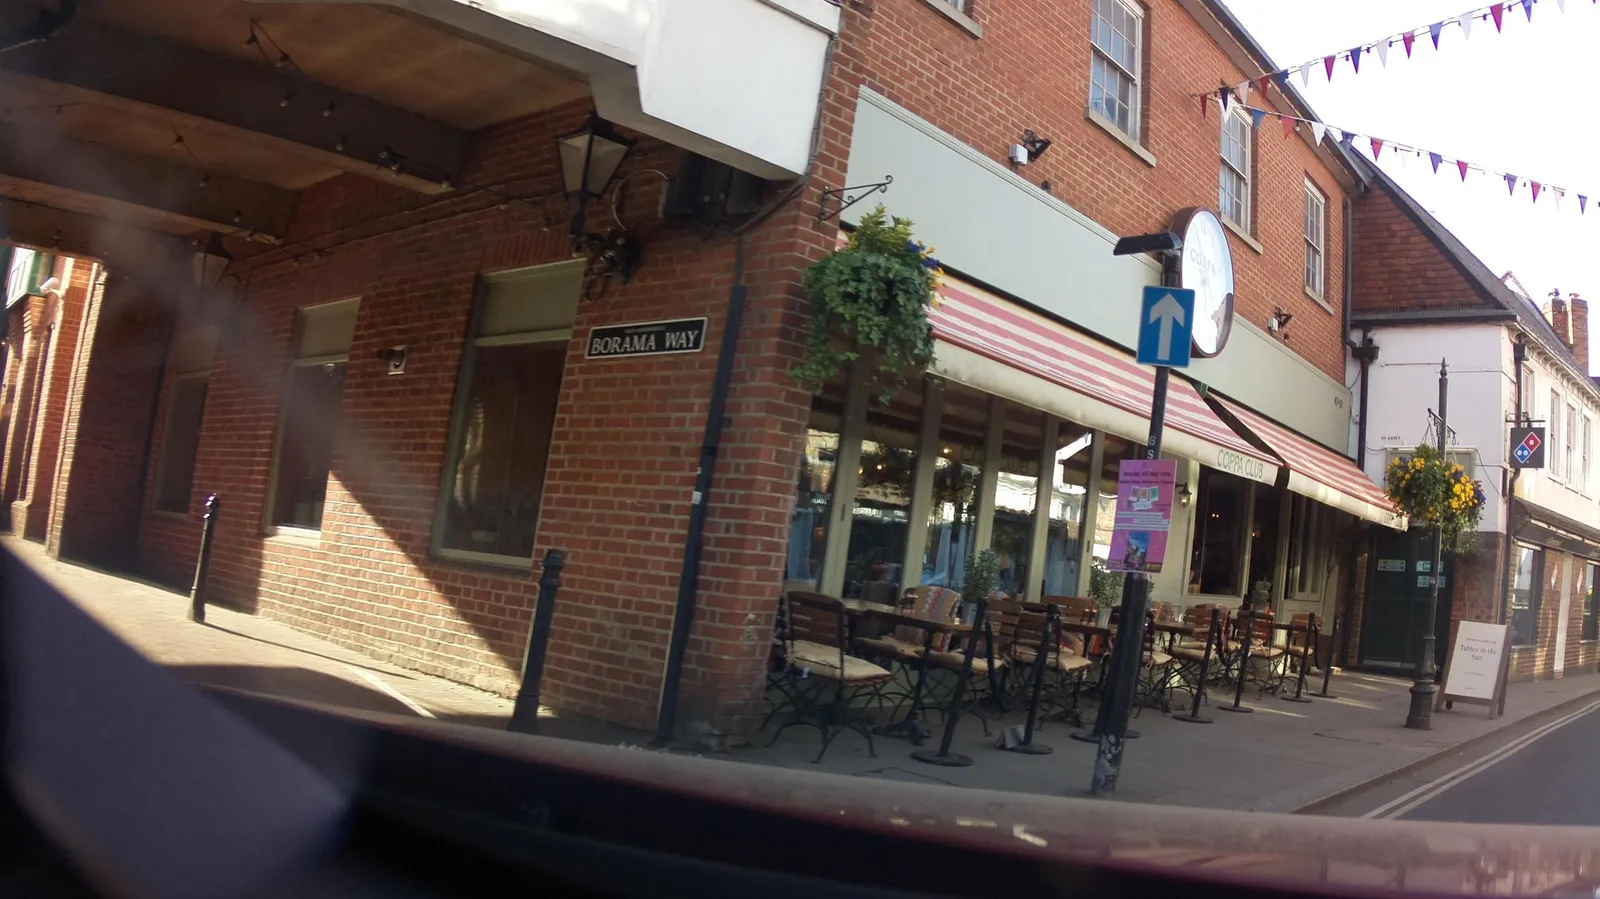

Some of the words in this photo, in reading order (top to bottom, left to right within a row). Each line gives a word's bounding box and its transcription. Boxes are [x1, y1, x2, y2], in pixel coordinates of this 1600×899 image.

[591, 334, 657, 354] BORAMA
[665, 330, 699, 349] WAY
[1217, 449, 1244, 474] COPPA
[1245, 459, 1264, 480] CLUB
[1460, 644, 1479, 653] Tables
[1487, 647, 1498, 655] the
